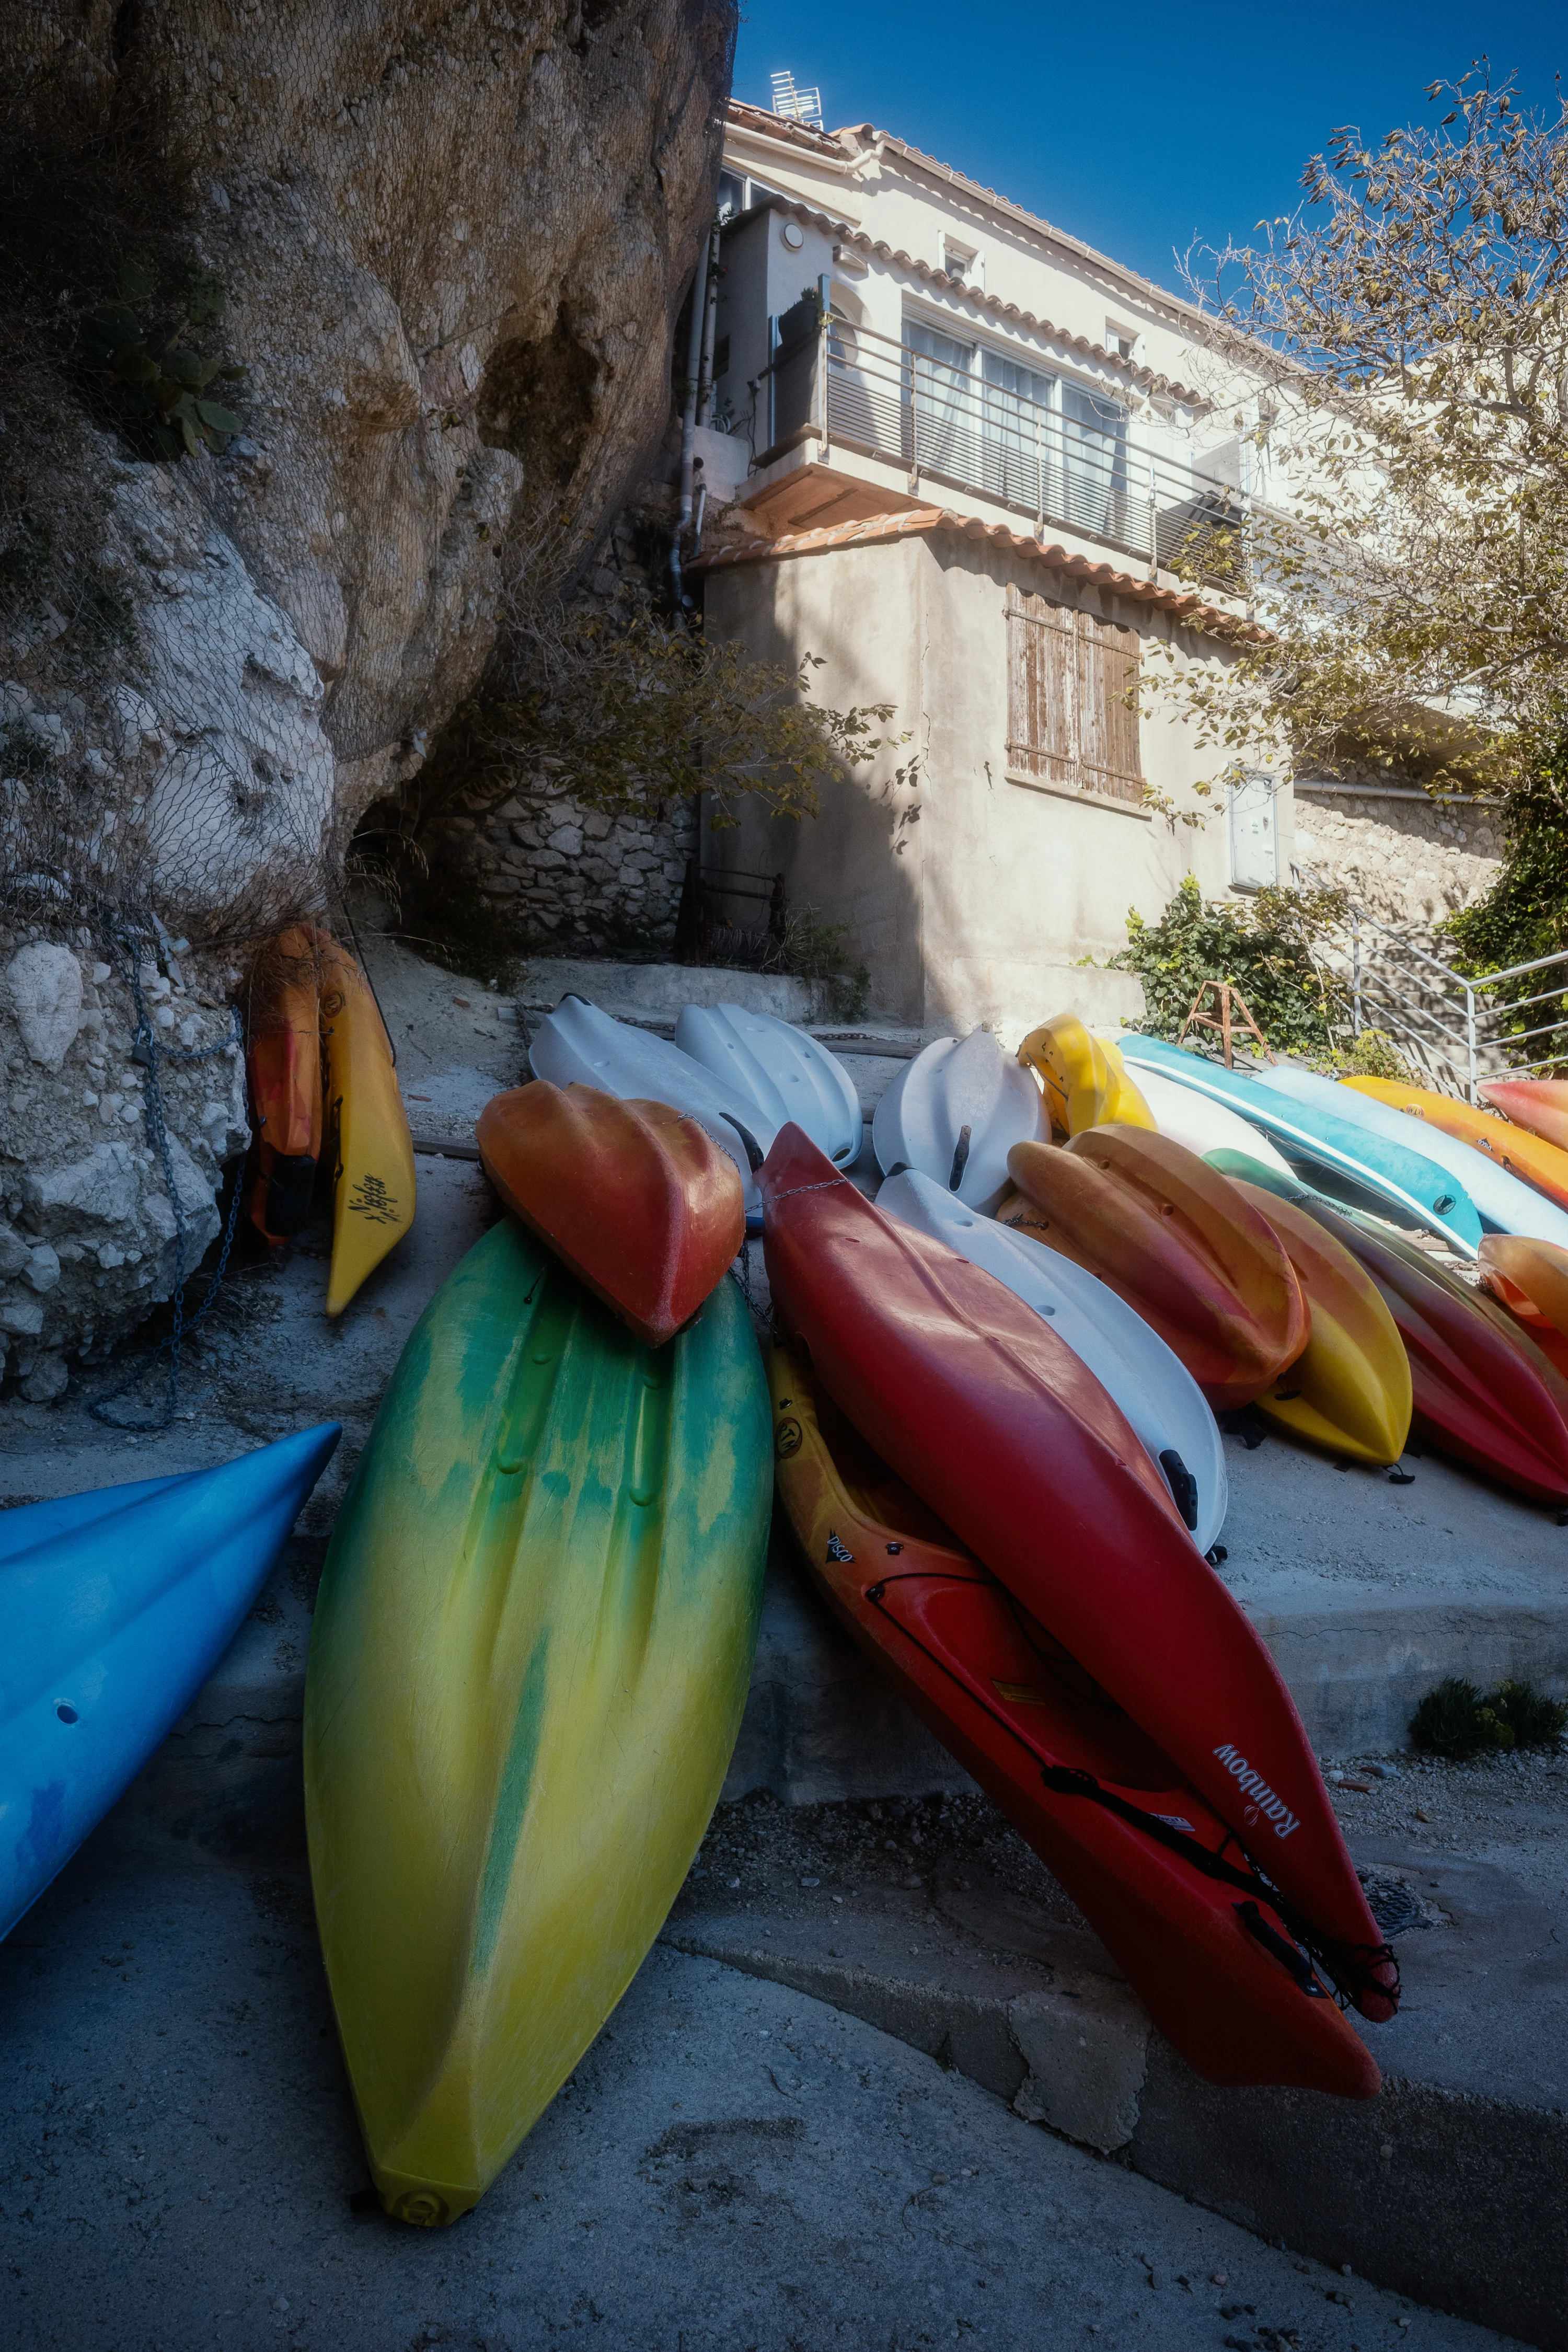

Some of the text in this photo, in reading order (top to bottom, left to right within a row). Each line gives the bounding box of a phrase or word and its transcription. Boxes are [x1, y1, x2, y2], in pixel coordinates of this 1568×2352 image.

[1408, 1106, 1423, 1115] RTM
[1478, 1139, 1492, 1151] DISCO
[778, 1421, 800, 1454] RTM
[826, 1536, 853, 1563] DISCO
[1213, 1743, 1301, 1840] Rainbow
